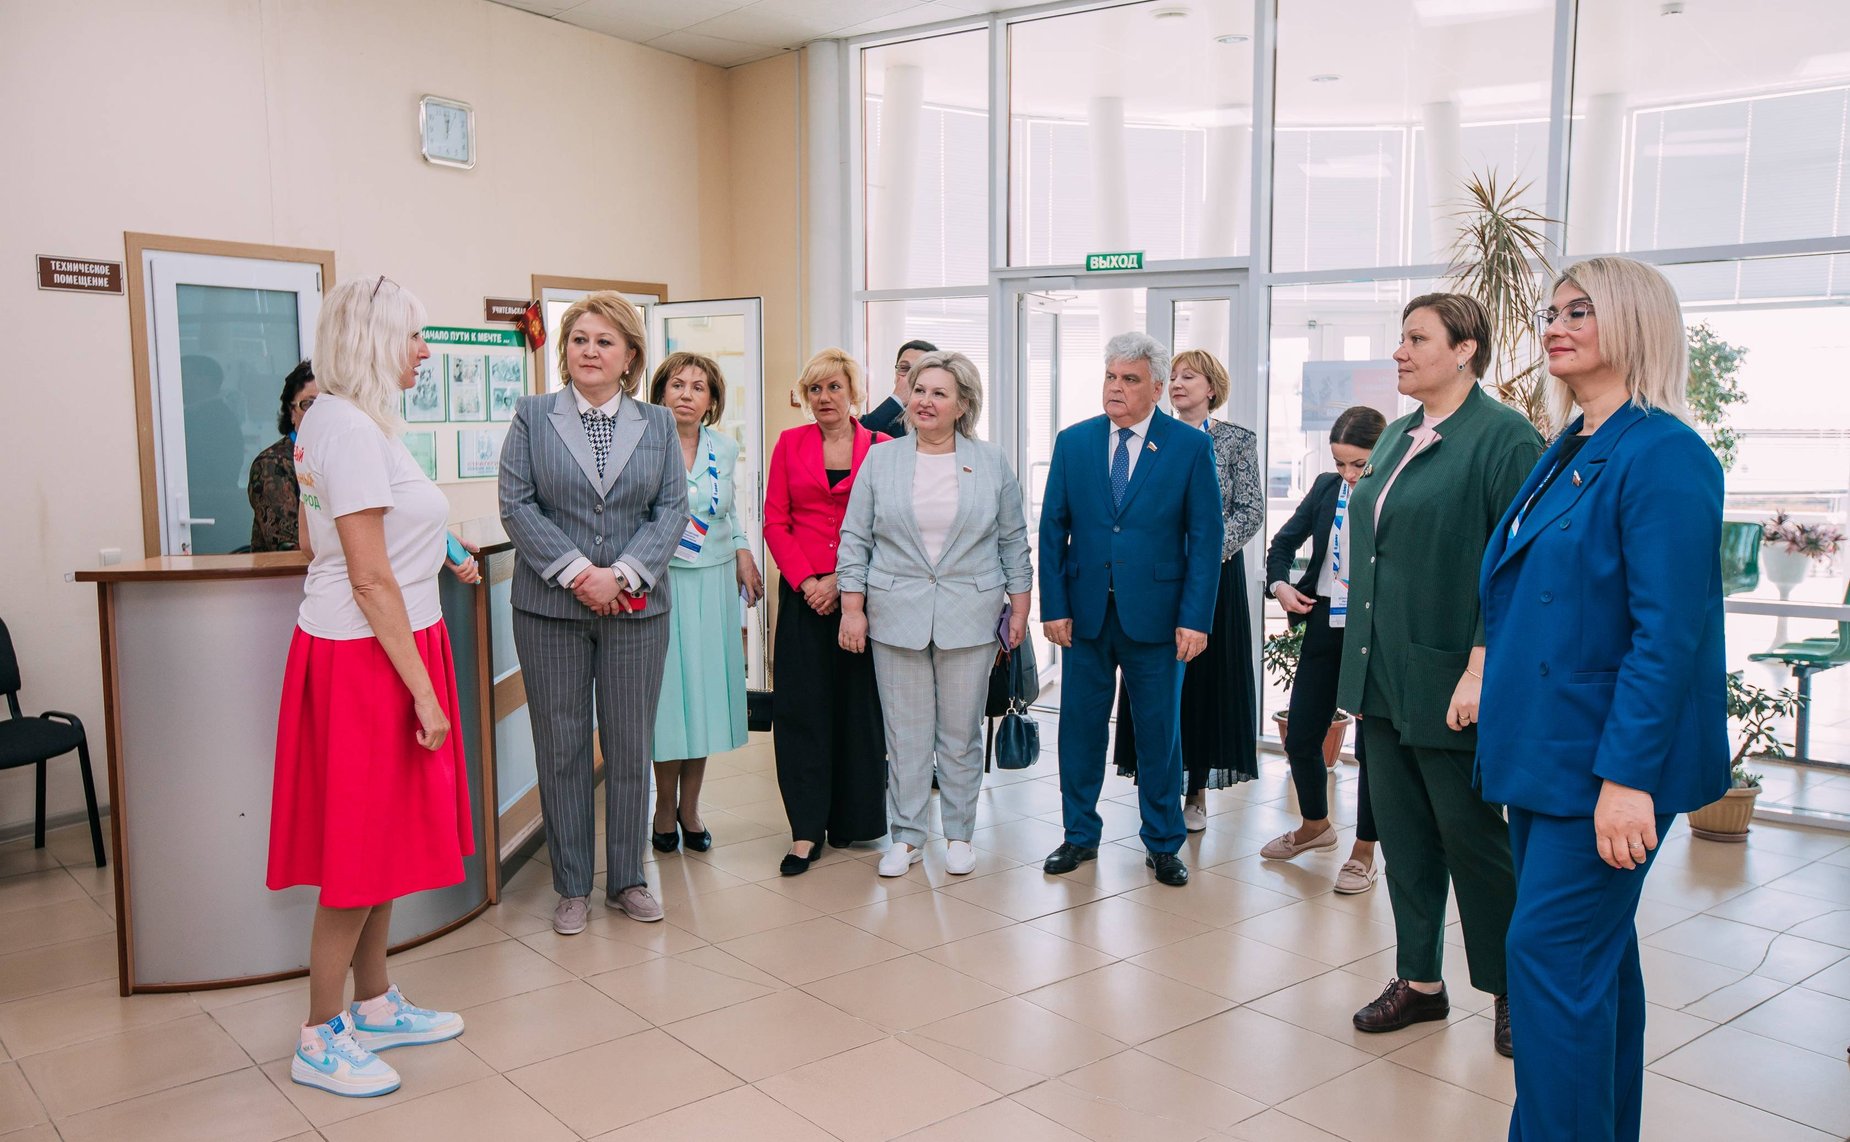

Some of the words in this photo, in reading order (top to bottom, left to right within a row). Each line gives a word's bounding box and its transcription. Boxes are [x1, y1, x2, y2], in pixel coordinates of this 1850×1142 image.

[50, 260, 110, 275] ТЕХНИЧЕСКОЕ
[1090, 254, 1138, 269] ВЫХОД
[53, 274, 109, 287] ПОМЕЩЕНИЕ
[421, 329, 449, 340] НАЧАЛО
[450, 330, 469, 342] ПУТИ
[471, 332, 476, 342] К
[477, 332, 502, 343] МЕЧТЕ
